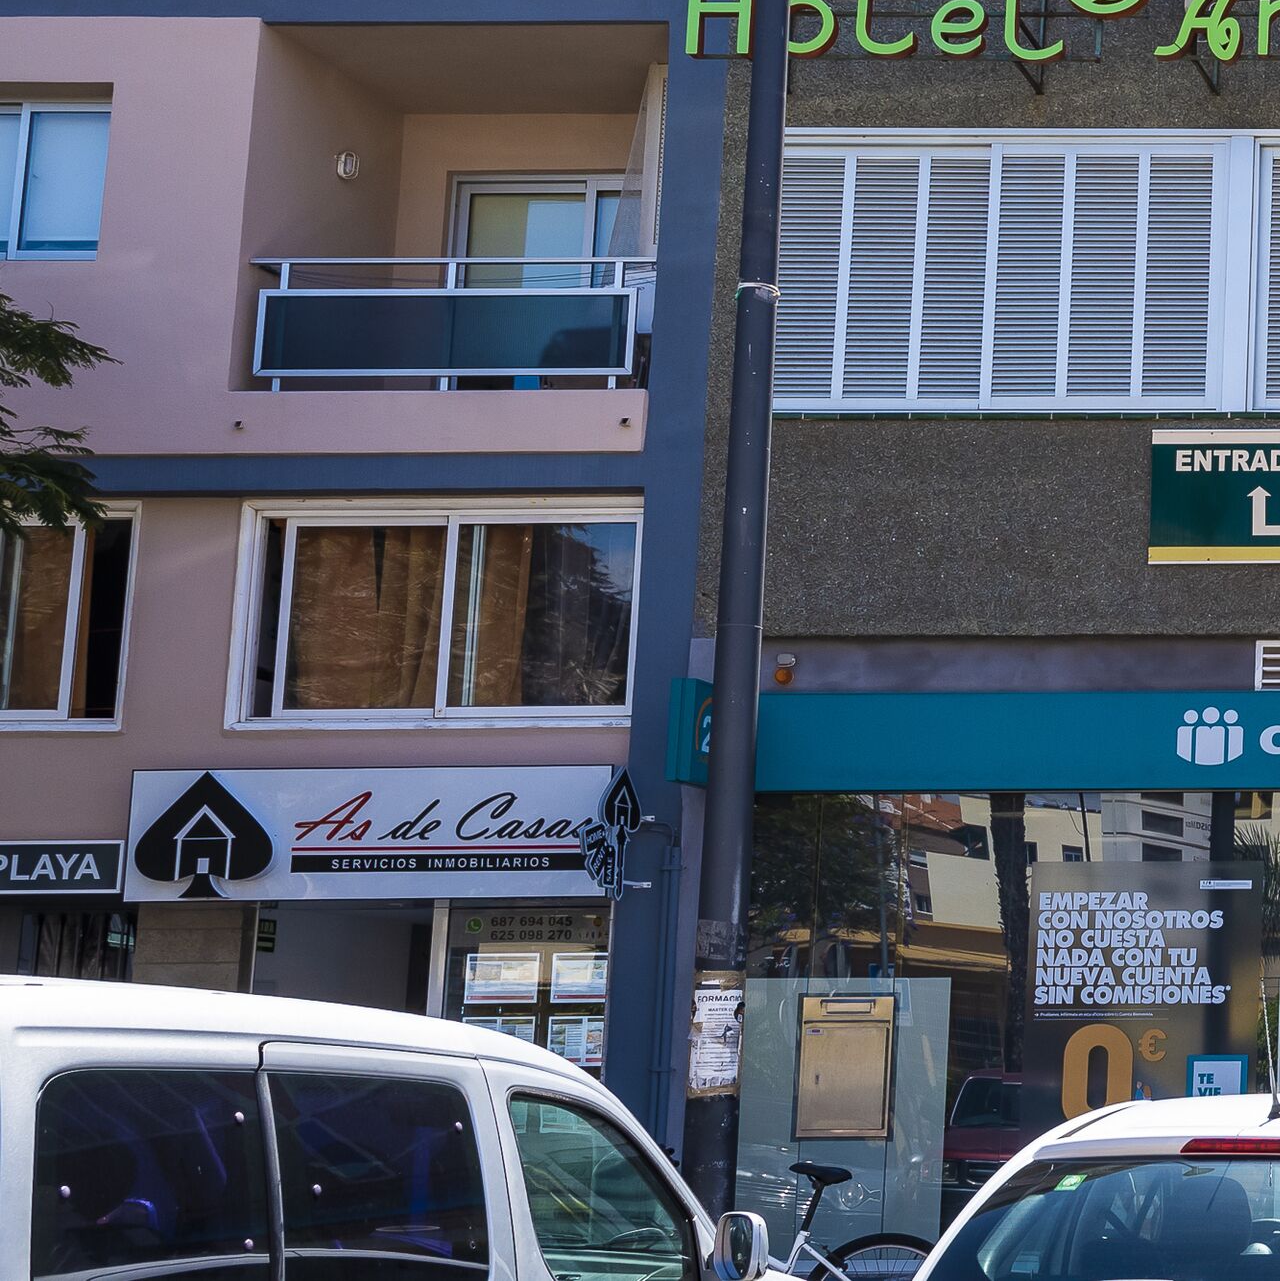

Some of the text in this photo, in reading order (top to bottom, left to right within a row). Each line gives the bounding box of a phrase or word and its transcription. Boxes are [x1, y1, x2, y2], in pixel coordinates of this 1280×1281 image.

[294, 791, 372, 842] As
[377, 798, 442, 841] de
[332, 856, 551, 870] SERVICIOS INMOBILIARIOS
[1039, 892, 1149, 910] EMPEZAR
[490, 917, 514, 927] 687
[519, 917, 543, 927] 694
[1038, 910, 1224, 929] CON NOSOTROS
[490, 930, 515, 940] 625
[519, 930, 543, 940] 098
[547, 930, 572, 940] 270
[1037, 929, 1166, 948] NO CUESTA
[1036, 948, 1197, 967] NADA CON TU
[1035, 967, 1212, 986] NUEVA CUENTA
[1034, 985, 1074, 1005] SIN
[1198, 1073, 1214, 1084] TE
